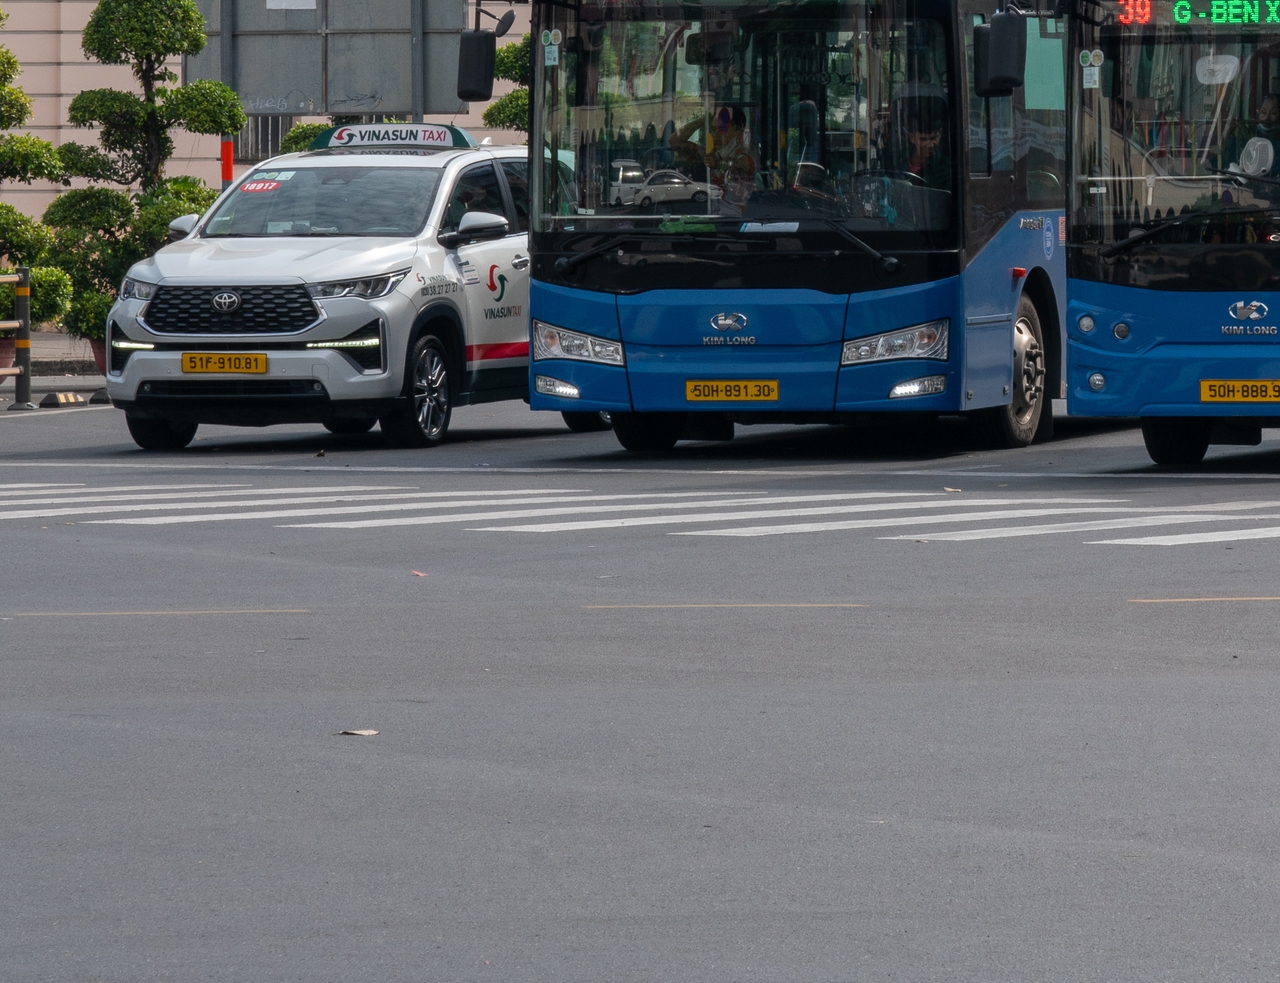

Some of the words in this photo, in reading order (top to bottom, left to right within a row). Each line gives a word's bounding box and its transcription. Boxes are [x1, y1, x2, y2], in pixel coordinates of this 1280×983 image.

[1173, 0, 1191, 24] G
[358, 129, 418, 142] VINASUN
[421, 129, 447, 142] TAXI
[243, 182, 278, 191] 18917
[1221, 325, 1245, 335] KIM
[1246, 325, 1278, 335] LONG
[702, 336, 725, 345] KIM
[727, 336, 757, 345] LONG
[189, 356, 259, 370] 51F-910.81
[693, 384, 771, 397] 50H-891.30
